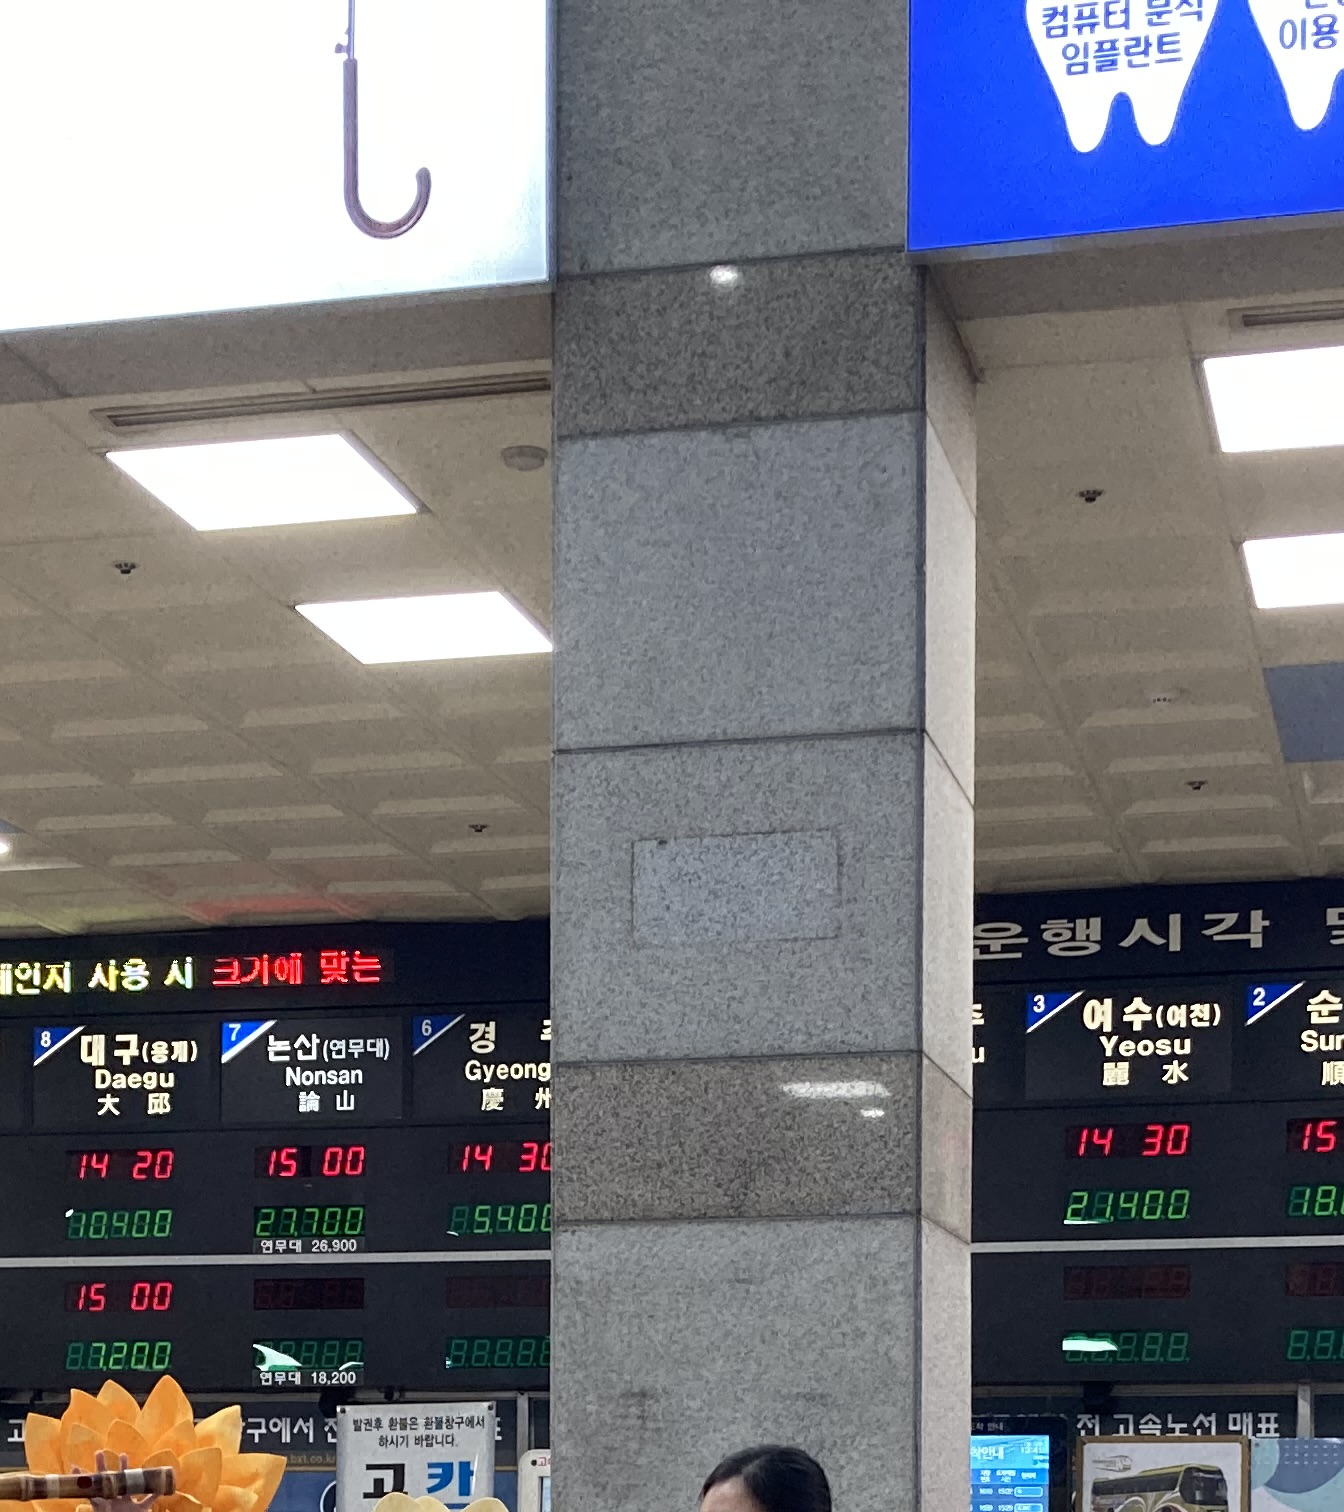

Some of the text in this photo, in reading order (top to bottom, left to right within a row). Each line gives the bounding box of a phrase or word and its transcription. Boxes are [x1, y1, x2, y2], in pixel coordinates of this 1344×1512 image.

[1277, 14, 1344, 52] 이용
[1059, 33, 1184, 77] 임플란트
[973, 908, 1270, 960] 운행시각
[87, 958, 150, 991] 사용
[163, 956, 194, 990] 시
[211, 951, 303, 988] 크기에
[319, 949, 383, 985] 맞는
[1033, 995, 1046, 1013] 3
[1253, 987, 1266, 1007] 2
[39, 1030, 52, 1048] 8
[228, 1024, 241, 1042] 7
[421, 1019, 433, 1037] 6
[267, 1032, 391, 1063] 논산(연무대)
[1100, 1035, 1192, 1057] Yeosu
[94, 1068, 175, 1091] Daegu
[285, 1066, 364, 1088] Nonsan
[1077, 1124, 1191, 1157] 14 30
[1301, 1120, 1337, 1152] 15
[78, 1150, 175, 1180] 14 20
[268, 1146, 366, 1176] 15 00
[461, 1144, 493, 1172] 14
[260, 1239, 357, 1253] 연무대 26,900
[76, 1280, 173, 1311] 15 00
[259, 1371, 356, 1385] 연무대 18,200
[351, 1414, 486, 1432] 발권후 환불은 환불창구에서
[1076, 1412, 1281, 1438] 전 고속노선 매표
[378, 1433, 460, 1449] 하시기 바랍니다.
